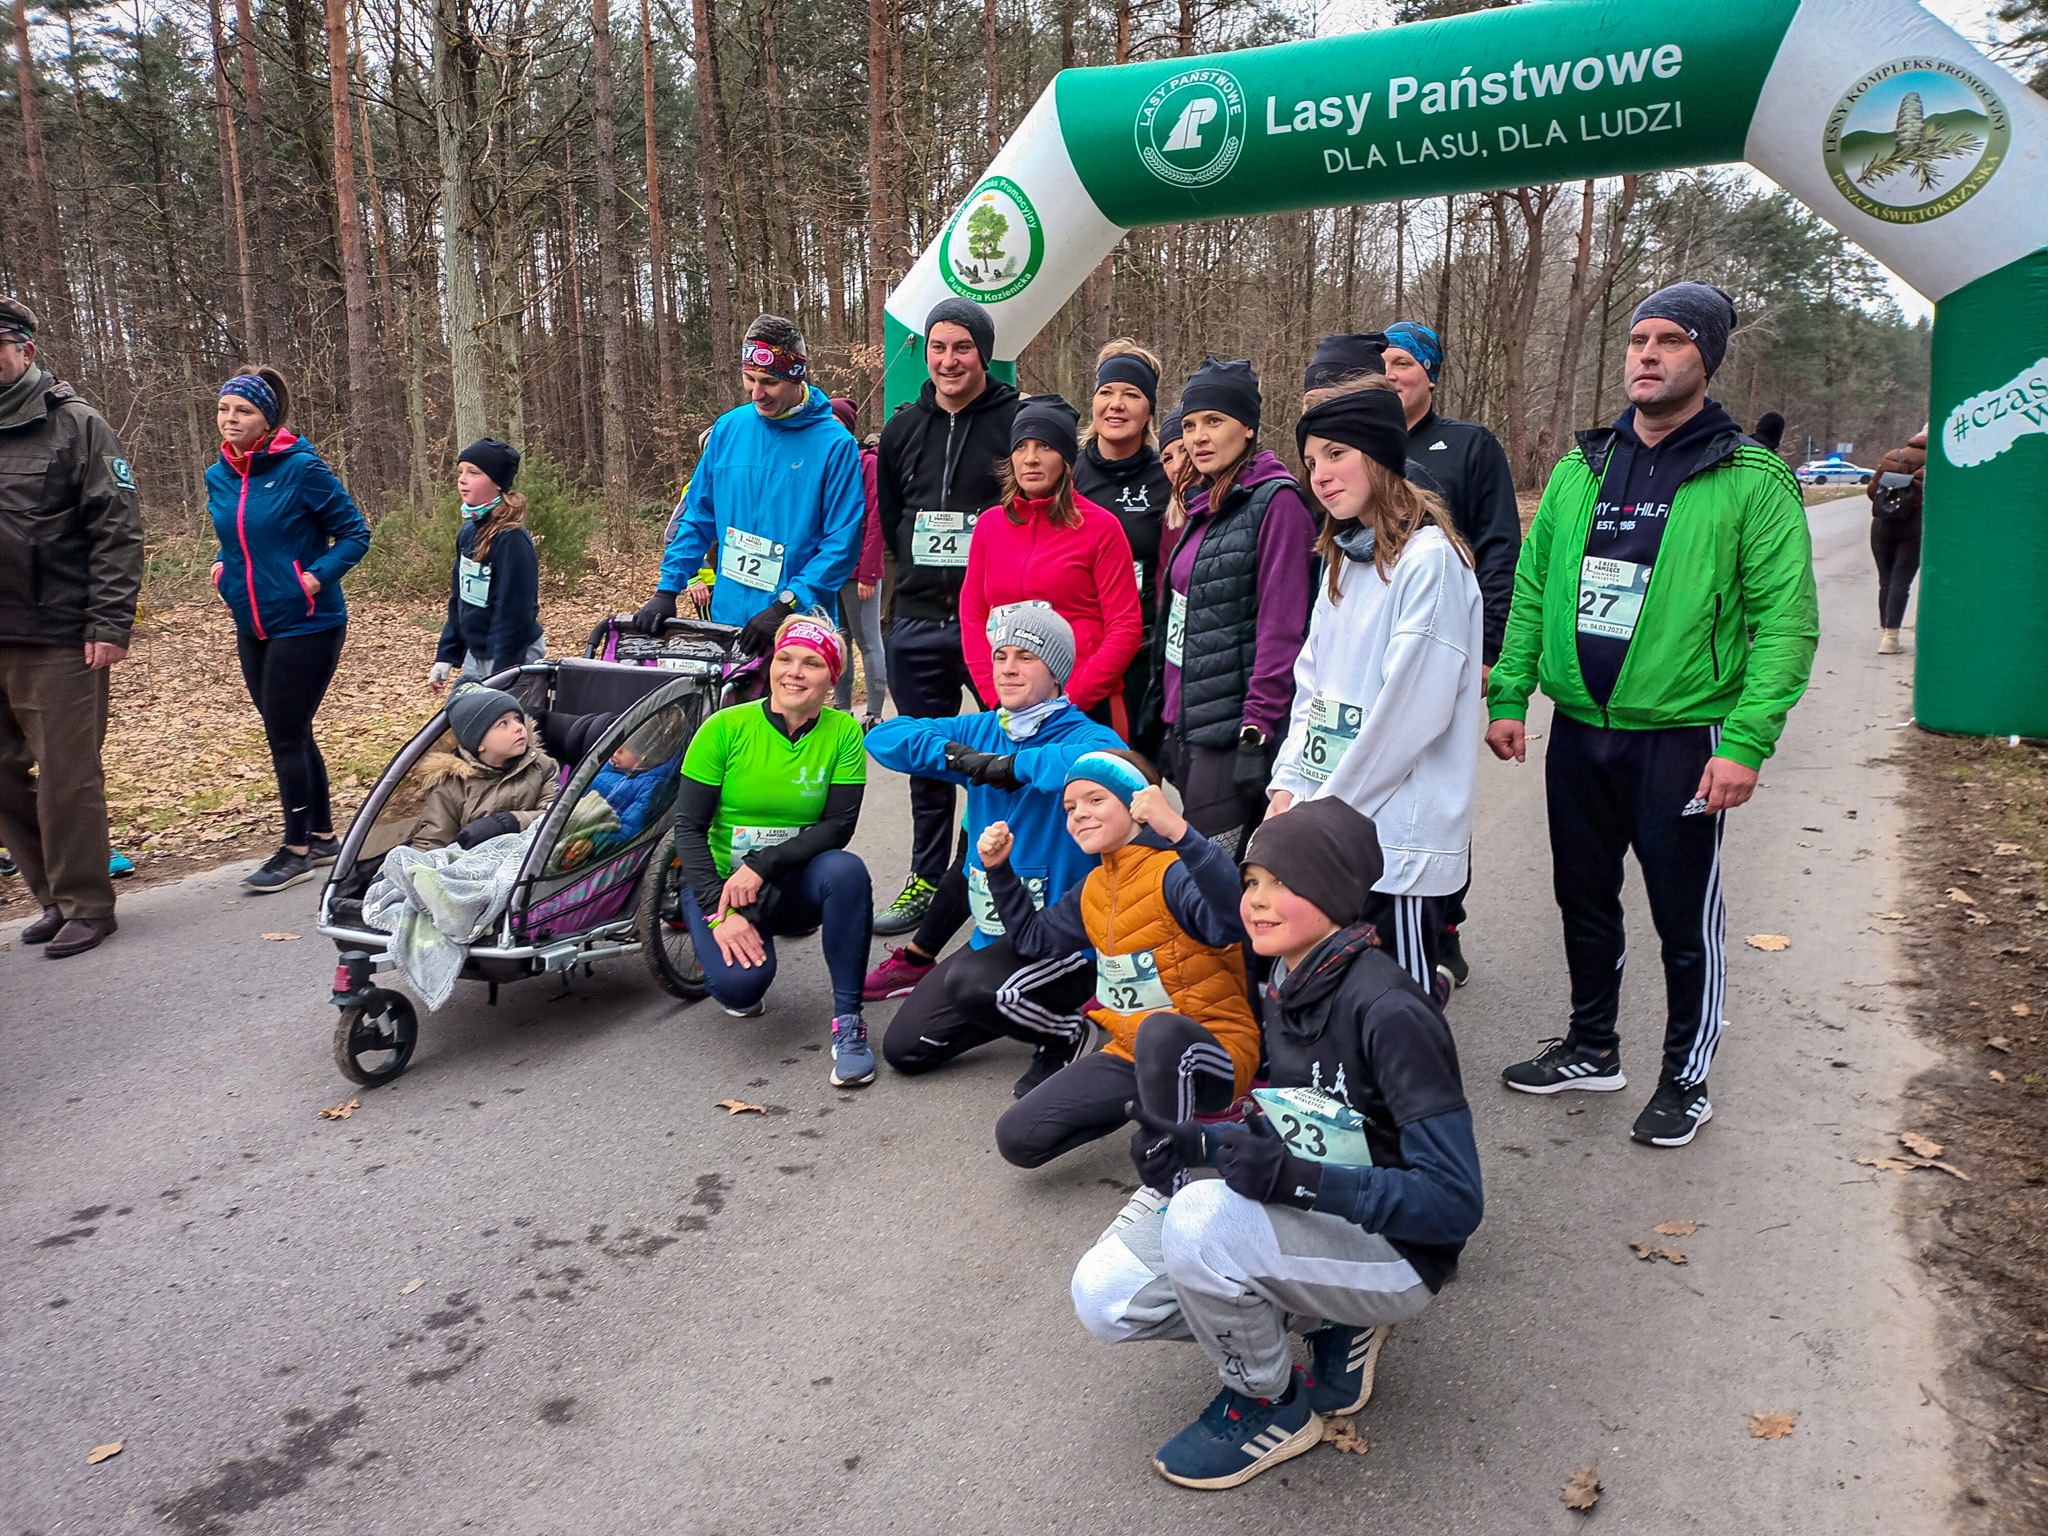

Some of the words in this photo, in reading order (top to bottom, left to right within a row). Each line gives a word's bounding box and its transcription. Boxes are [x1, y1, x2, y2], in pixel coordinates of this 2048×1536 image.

[1140, 87, 1166, 126] LASY
[1170, 71, 1241, 115] PAŃSTWOWE
[1266, 91, 1372, 135] Lasy
[1388, 43, 1682, 119] Państwowe
[1826, 106, 1849, 153] LEŚNY
[1847, 60, 1933, 103] KOMPLEKS
[1937, 58, 2006, 133] PROMOCYJNY
[1324, 144, 1387, 174] DLA
[1396, 130, 1488, 165] LASU,
[1499, 120, 1567, 152] DLA
[1580, 101, 1681, 141] LUDZI
[1833, 173, 1880, 217] PUSZCZA
[1882, 155, 2000, 224] ŚWIĘTOKRZYSKA
[947, 276, 982, 301] Puszcza
[984, 273, 1032, 301] Kozienicka
[1596, 520, 1616, 530] EST.
[1619, 520, 1637, 530] 1985
[928, 535, 957, 554] 24
[737, 555, 761, 577] 12
[1578, 590, 1620, 618] 27
[1590, 623, 1623, 635] 04.03.2023
[1108, 987, 1144, 1009] 32
[1281, 1114, 1327, 1157] 23
